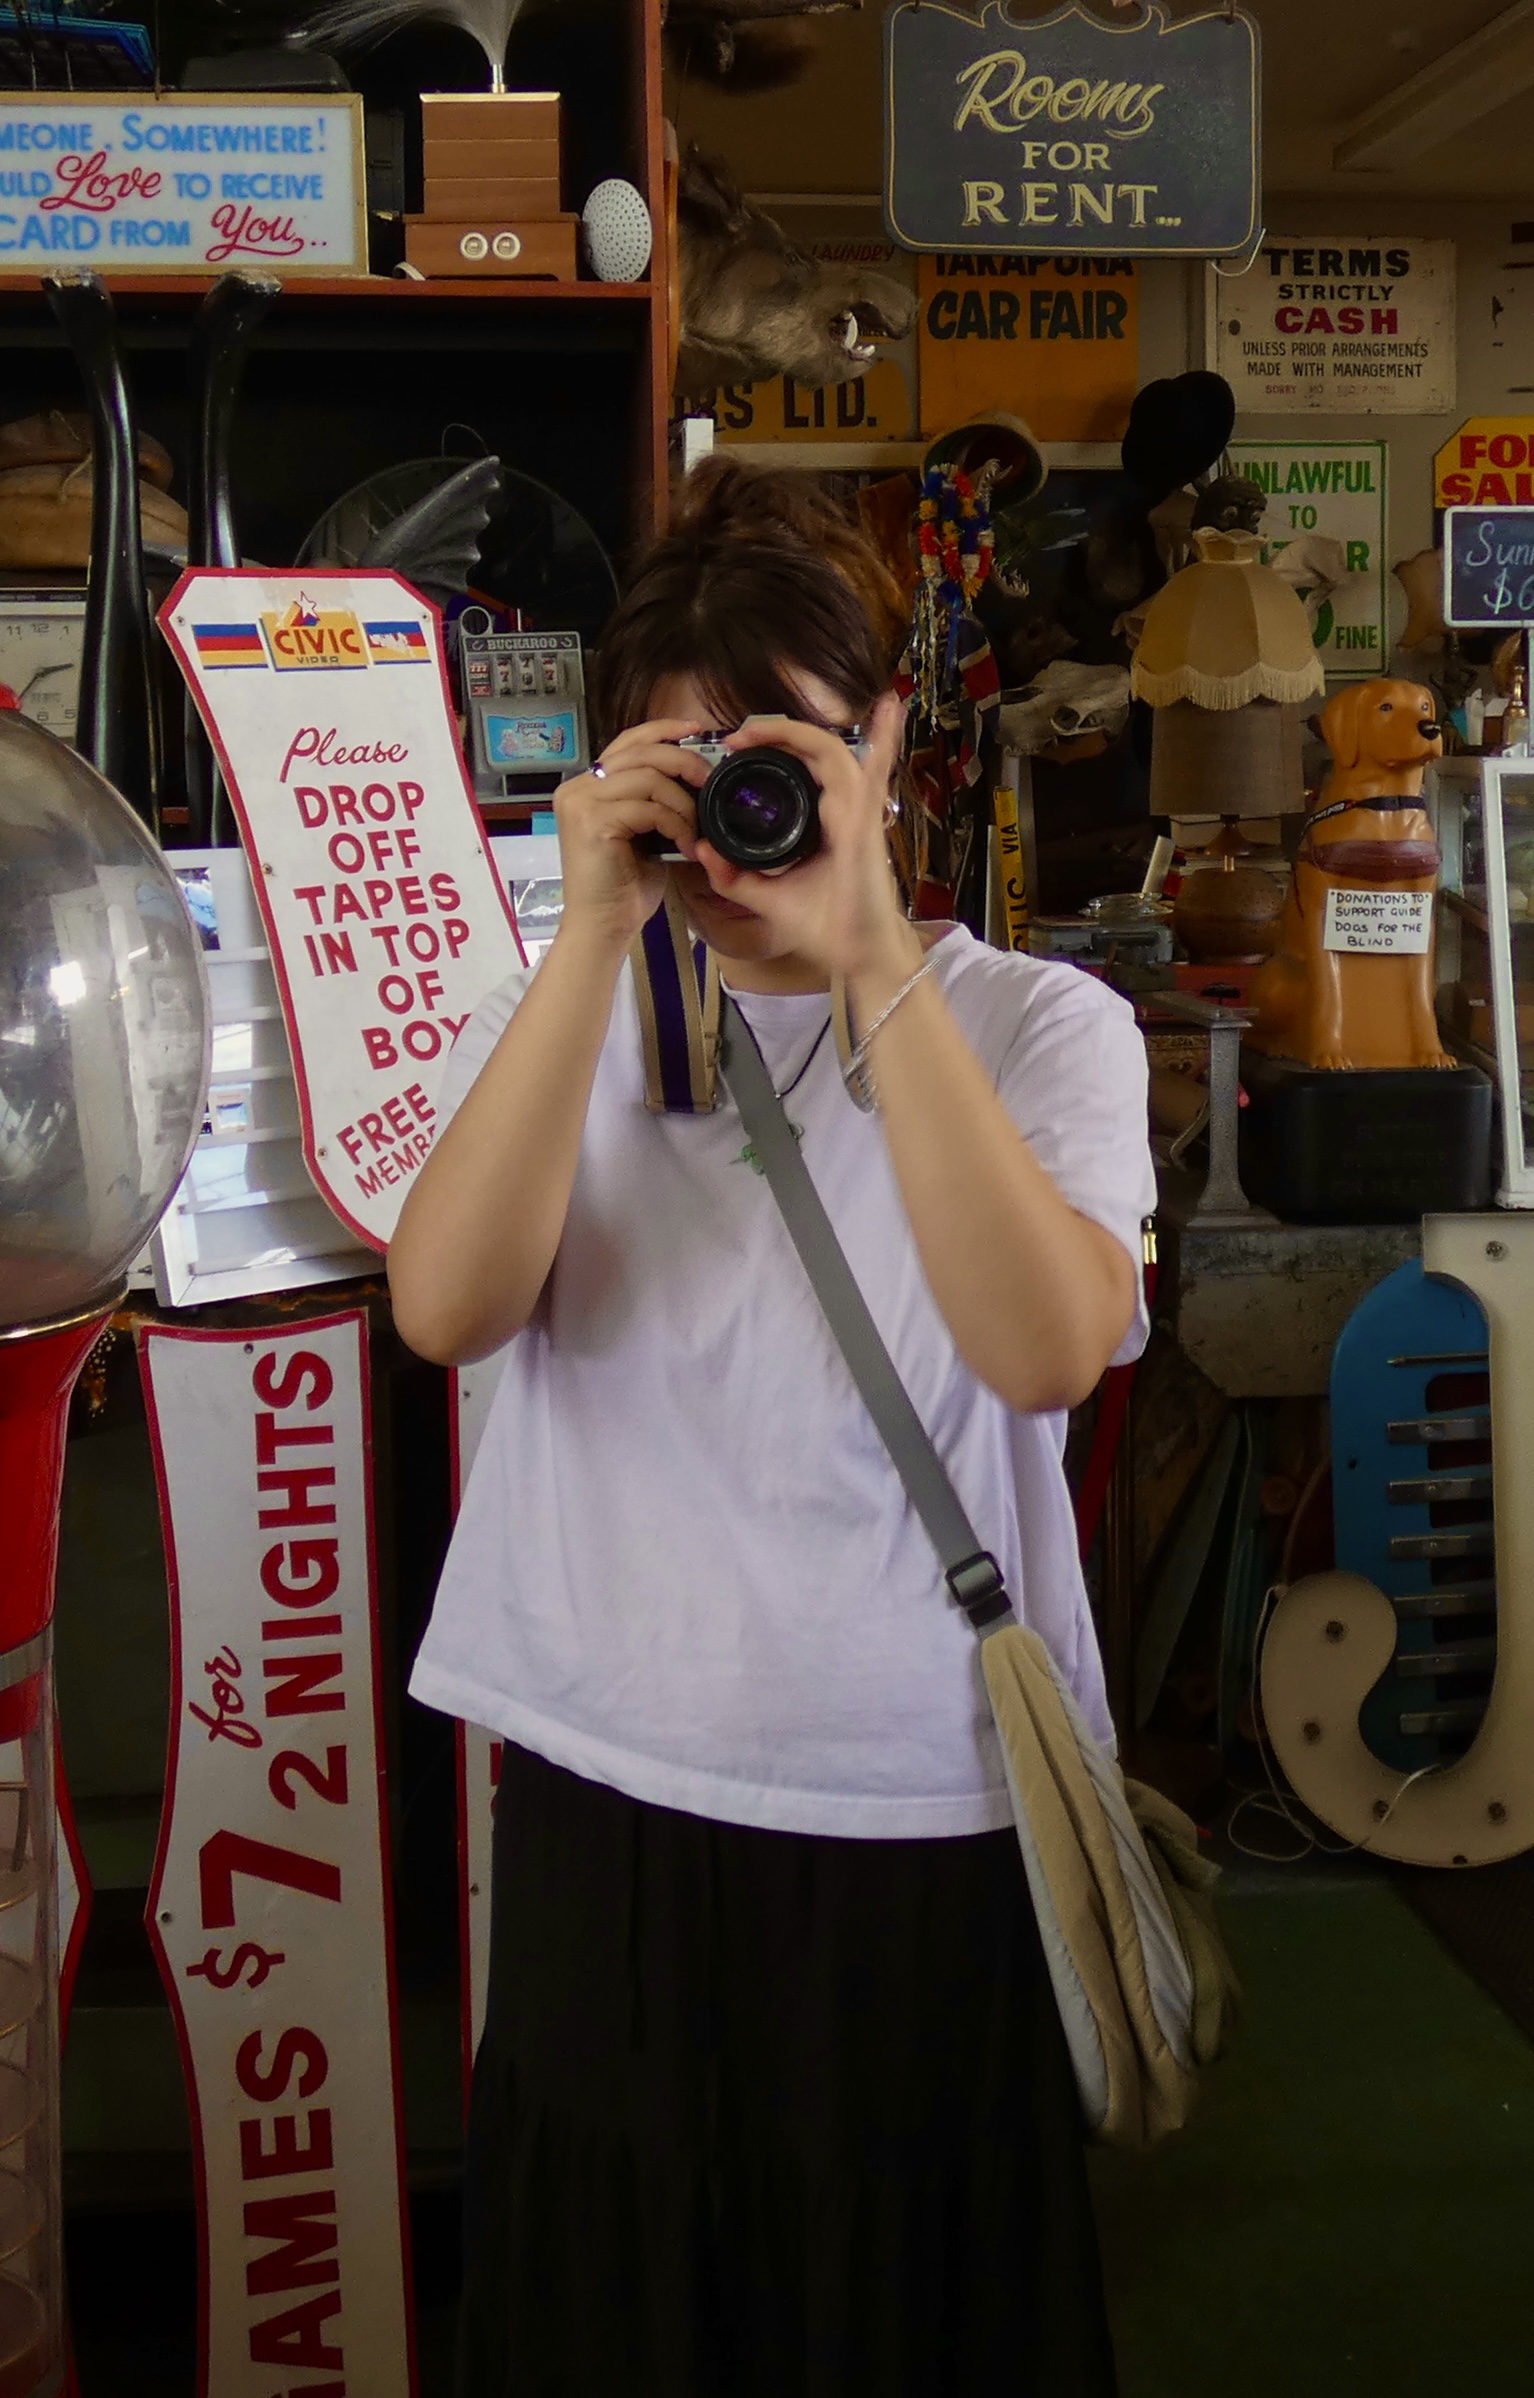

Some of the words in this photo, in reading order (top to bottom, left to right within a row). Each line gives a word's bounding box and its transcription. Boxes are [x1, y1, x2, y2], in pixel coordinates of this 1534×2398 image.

[953, 49, 1165, 140] Rooms
[1021, 140, 1112, 171] FOR
[38, 150, 162, 212] Love
[172, 172, 213, 201] TO
[221, 172, 325, 201] RECEIVE
[110, 218, 191, 248] FROM
[1261, 248, 1411, 278] TERMS
[1278, 284, 1394, 301] STRICTLY
[926, 289, 1020, 340] CAR
[1029, 290, 1129, 339] FAIR
[1274, 306, 1399, 335] CASH
[1242, 341, 1287, 357] UNLESS
[1291, 342, 1327, 357] PRIOR
[1331, 342, 1429, 359] ARRANGEMENTS
[1247, 361, 1282, 377] MADE
[1292, 362, 1325, 378] WITH
[1333, 363, 1424, 379] MANAGEMENT
[1288, 505, 1318, 529] TO
[6, 625, 22, 636] 11
[31, 623, 50, 634] 12
[273, 627, 361, 656] CIVIC
[1335, 625, 1380, 649] FINE
[487, 636, 558, 652] BUCKAROO
[279, 726, 410, 784] Please
[293, 781, 425, 828] DROP
[328, 828, 421, 874] OFF
[293, 872, 461, 925] TAPES
[1335, 906, 1386, 917] SUPPORT
[1390, 906, 1423, 917] GUIDE
[1335, 921, 1369, 933] DOGS
[1377, 923, 1399, 933] FOR
[1401, 923, 1423, 933] THE
[1347, 935, 1394, 947] BLIND
[303, 931, 359, 977] IN
[370, 918, 470, 967] TOP
[377, 970, 445, 1015] OF
[335, 1082, 437, 1166] FREE
[252, 1349, 347, 1718] NIGHTS
[188, 1645, 263, 1749] for
[267, 1744, 349, 1811] 2
[186, 1828, 342, 1990] $7
